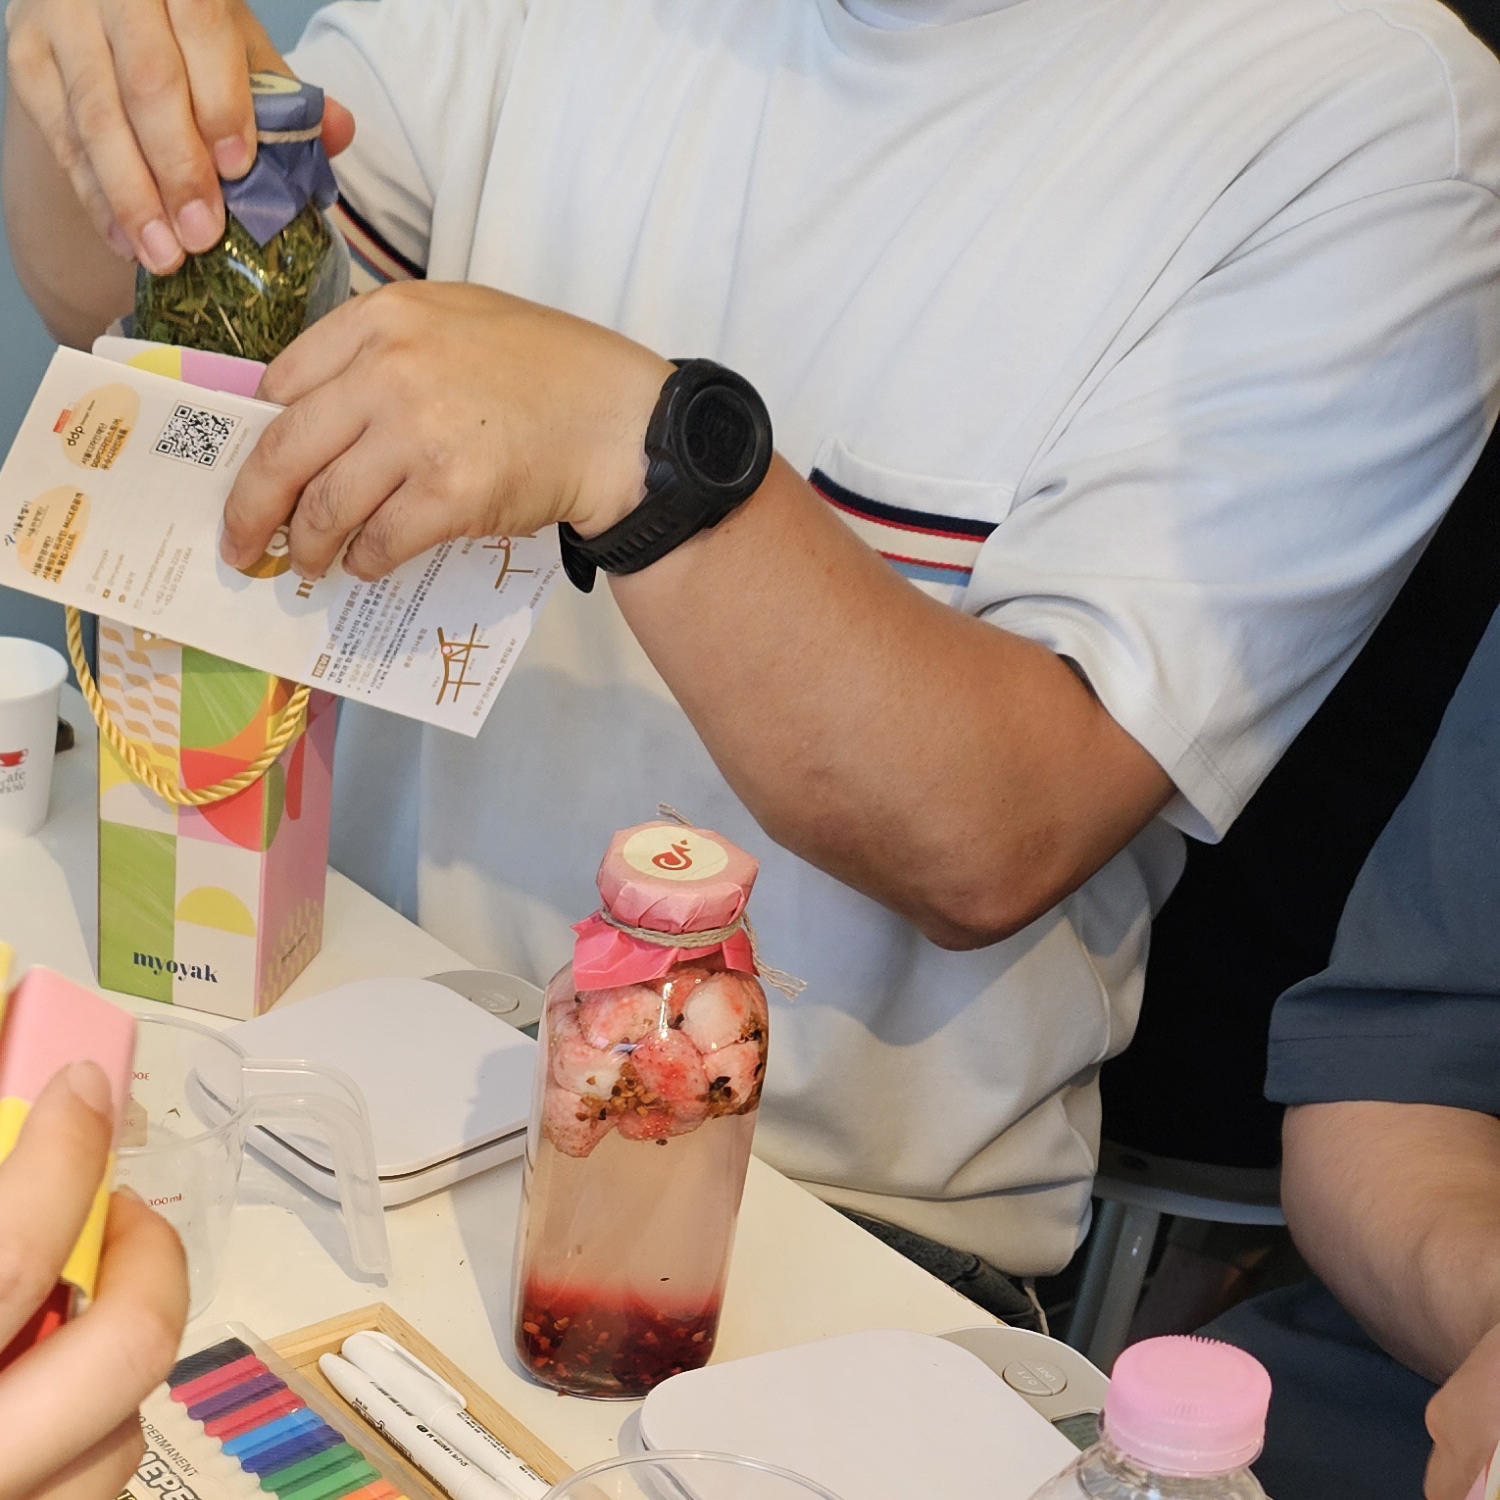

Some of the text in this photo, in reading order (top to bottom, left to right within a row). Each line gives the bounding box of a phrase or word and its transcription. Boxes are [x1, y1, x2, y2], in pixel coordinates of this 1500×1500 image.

[64, 423, 87, 449] ddp
[80, 421, 108, 465] 서울디자인재단
[10, 499, 31, 536] 서울특별시
[313, 654, 330, 677] NEW
[133, 950, 218, 983] myoyak
[141, 1418, 201, 1477] PERMANENT
